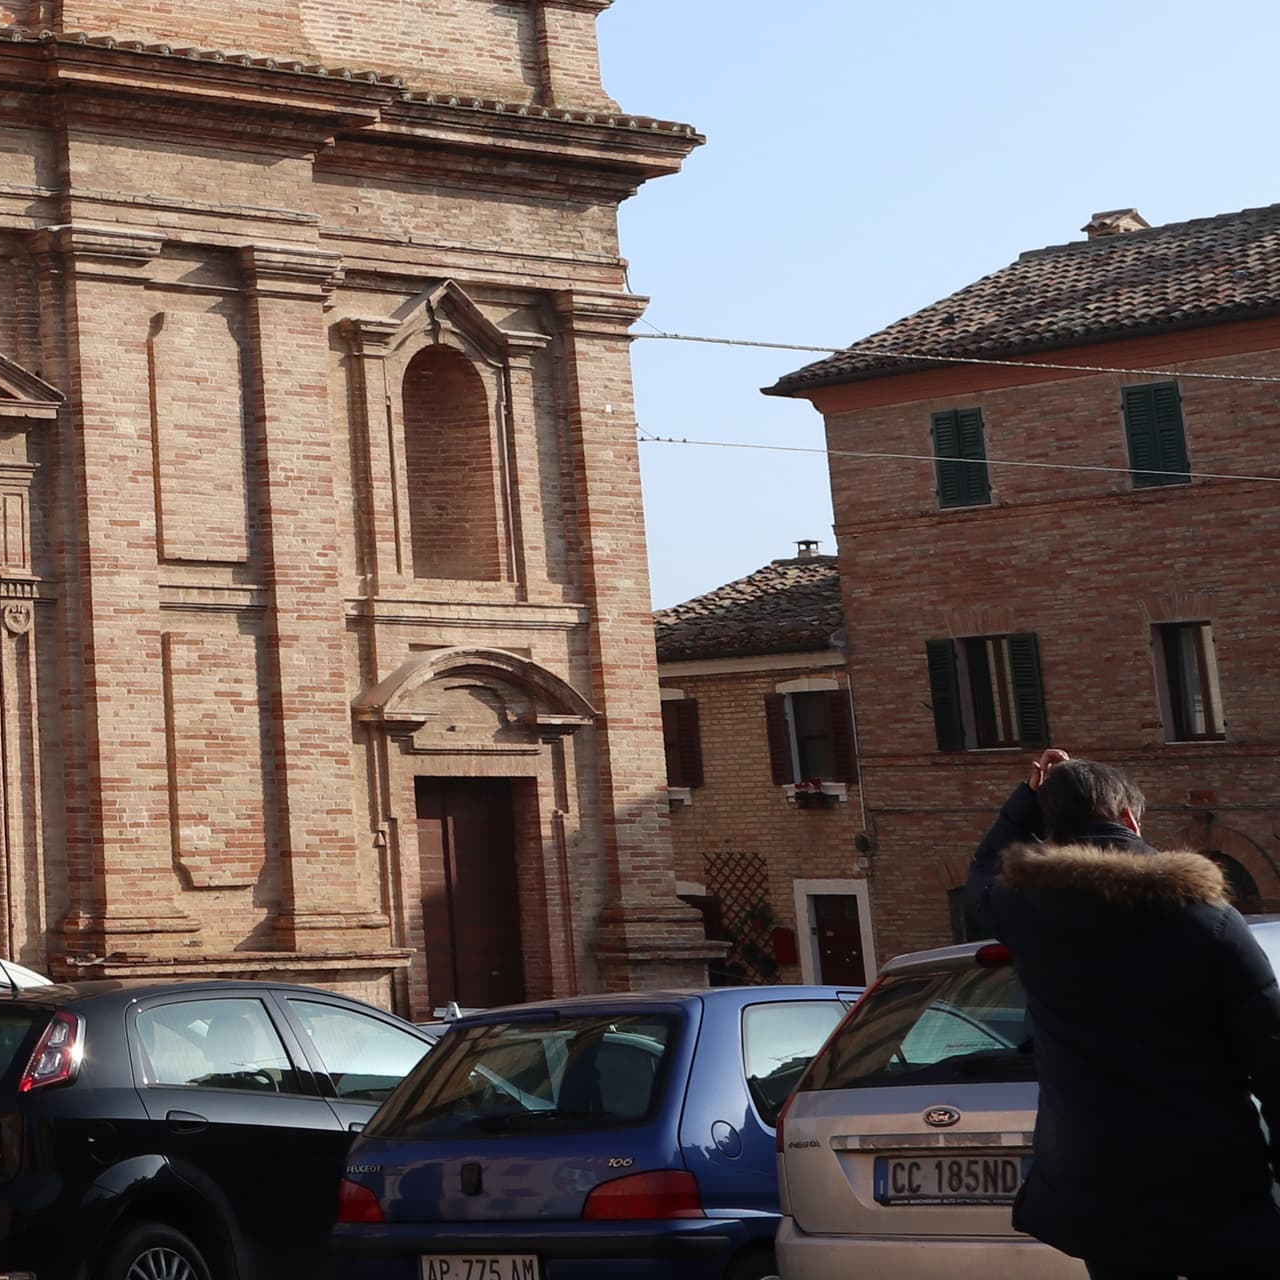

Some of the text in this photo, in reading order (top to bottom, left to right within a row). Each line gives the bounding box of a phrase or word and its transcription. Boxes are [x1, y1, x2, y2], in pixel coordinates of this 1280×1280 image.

[928, 1112, 951, 1122] Ford
[608, 1157, 633, 1168] 106
[891, 1161, 922, 1194] CC
[935, 1159, 1018, 1194] 185ND
[429, 1259, 535, 1280] AP 775 AM
